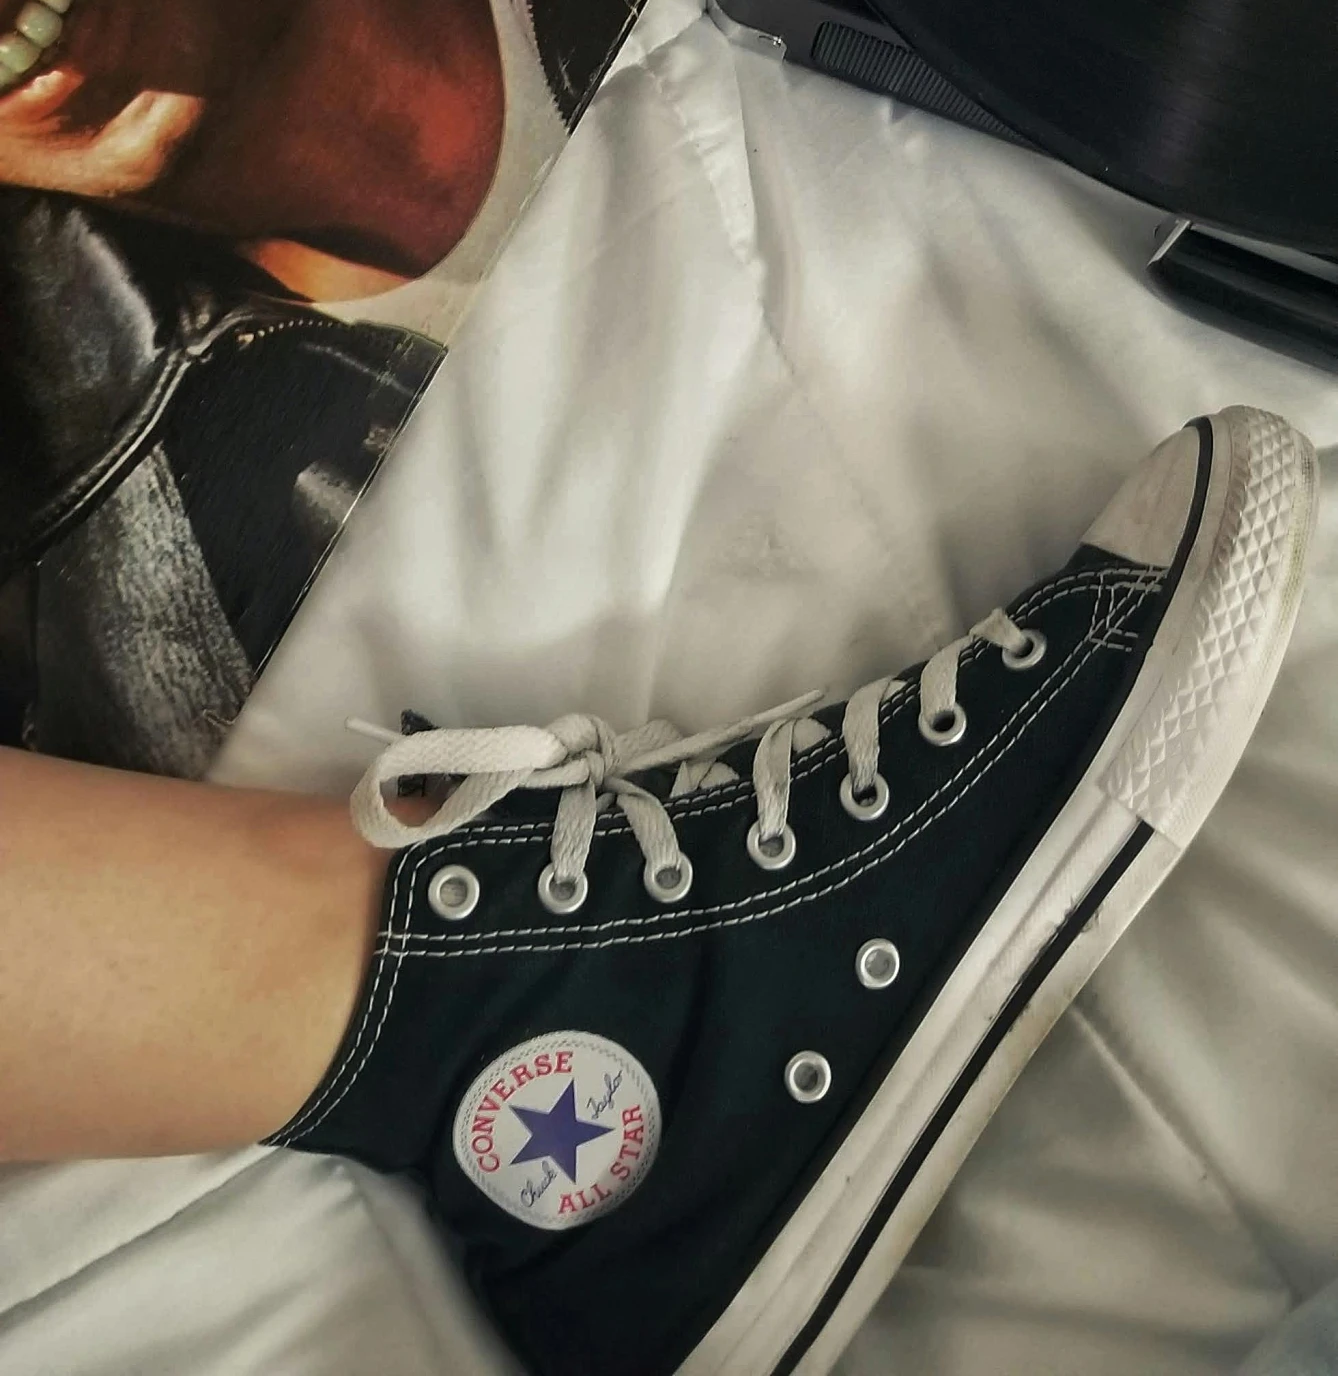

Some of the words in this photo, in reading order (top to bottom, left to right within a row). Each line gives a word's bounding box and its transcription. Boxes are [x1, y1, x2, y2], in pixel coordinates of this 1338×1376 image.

[471, 1050, 574, 1173] CONVERSE
[558, 1183, 612, 1214] ALL
[610, 1104, 645, 1181] STAR
[520, 1160, 557, 1208] Chuck
